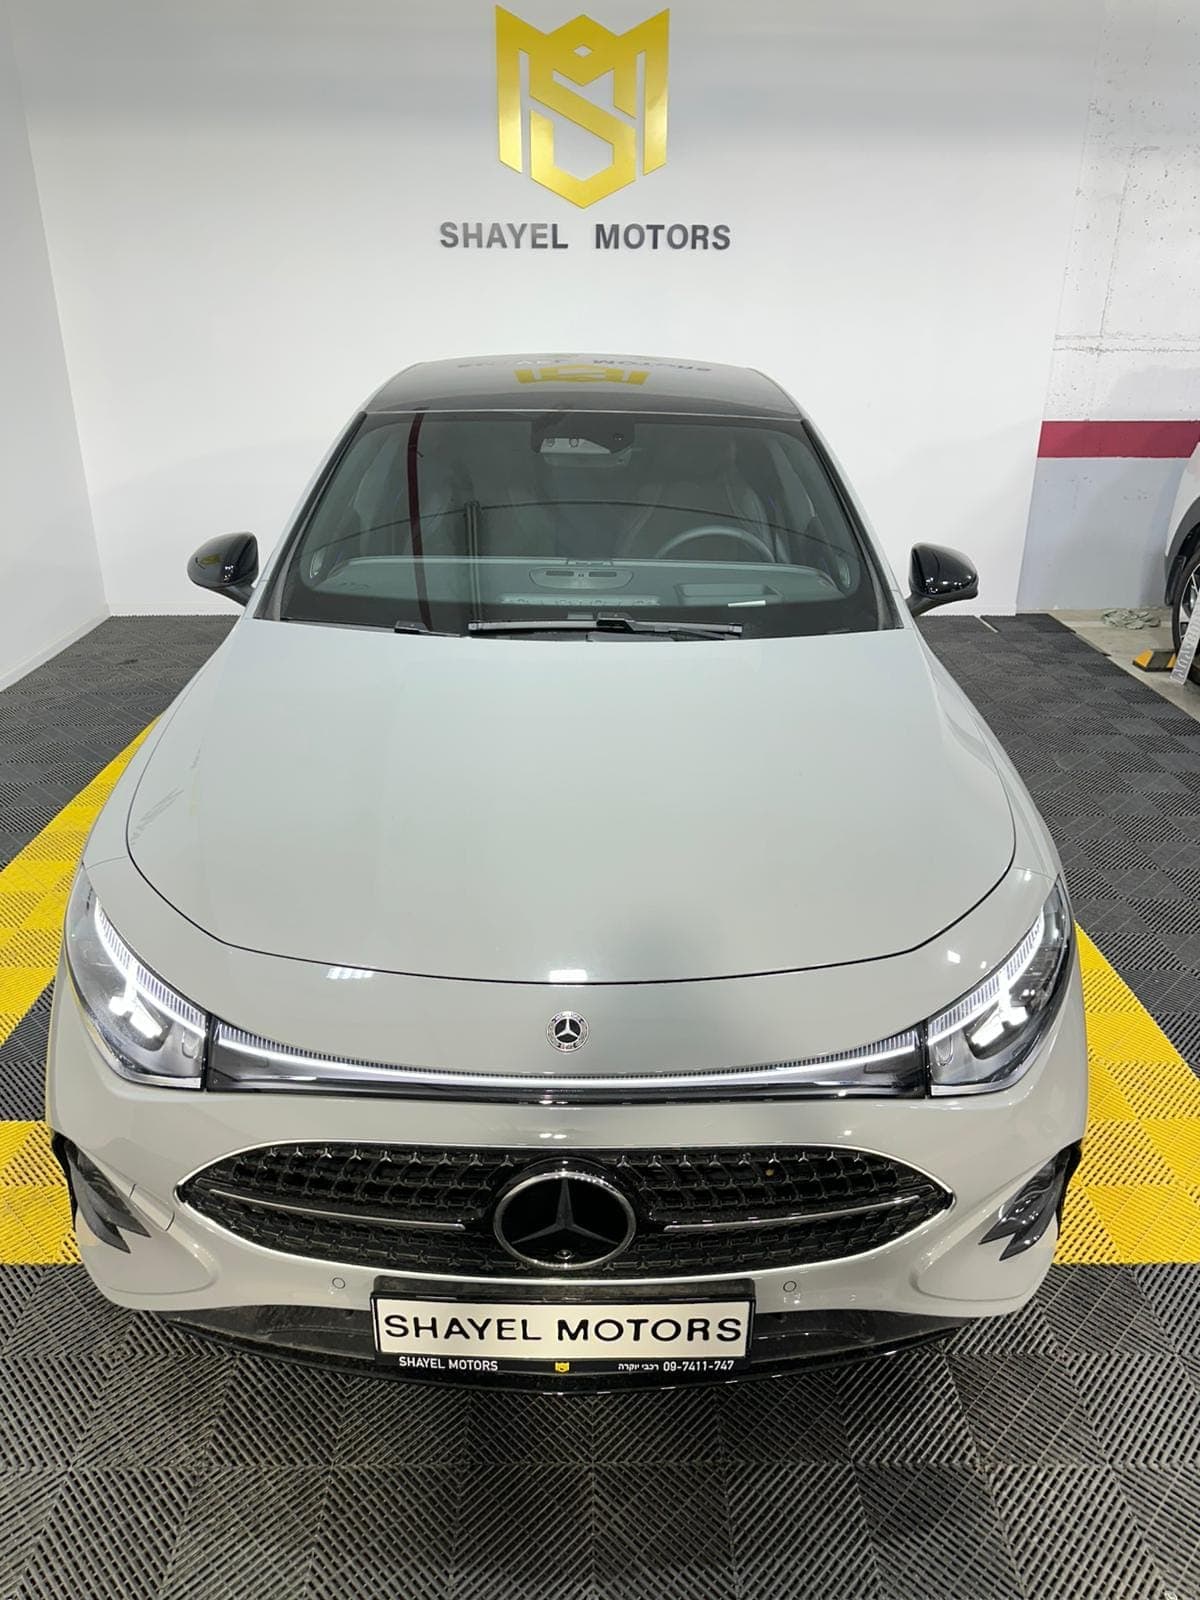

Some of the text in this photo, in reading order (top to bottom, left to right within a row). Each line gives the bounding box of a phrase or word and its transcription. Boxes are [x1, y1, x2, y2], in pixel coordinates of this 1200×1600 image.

[440, 221, 731, 250] SHAYEL MOTORS
[383, 1314, 742, 1342] SHAYEL MOTORS
[398, 1356, 499, 1371] SHAYEL MOTORS
[662, 1360, 735, 1372] 09-7411-747
